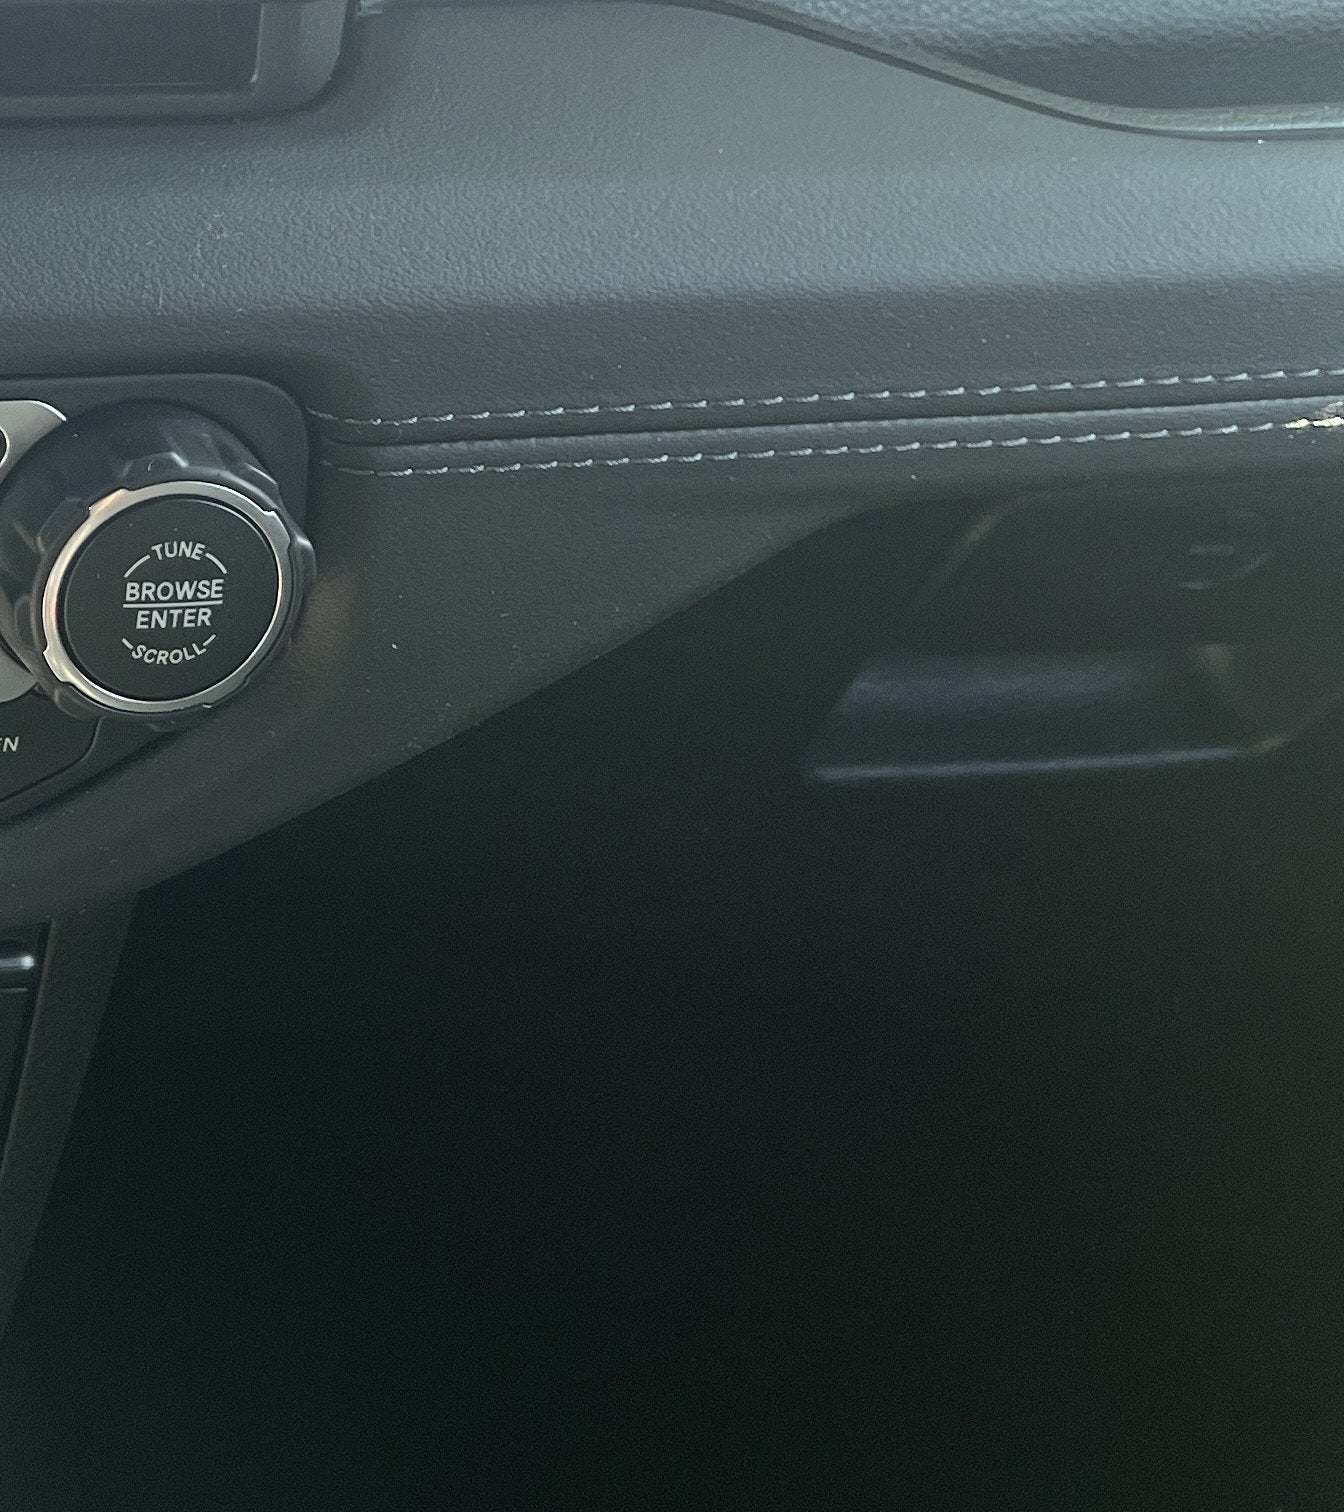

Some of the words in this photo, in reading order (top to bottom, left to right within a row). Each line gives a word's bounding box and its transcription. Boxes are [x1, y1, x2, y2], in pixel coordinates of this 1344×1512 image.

[151, 541, 207, 561] TUNE
[124, 578, 225, 601] BROWSE
[135, 607, 213, 630] ENTER
[131, 641, 207, 665] SCROLL
